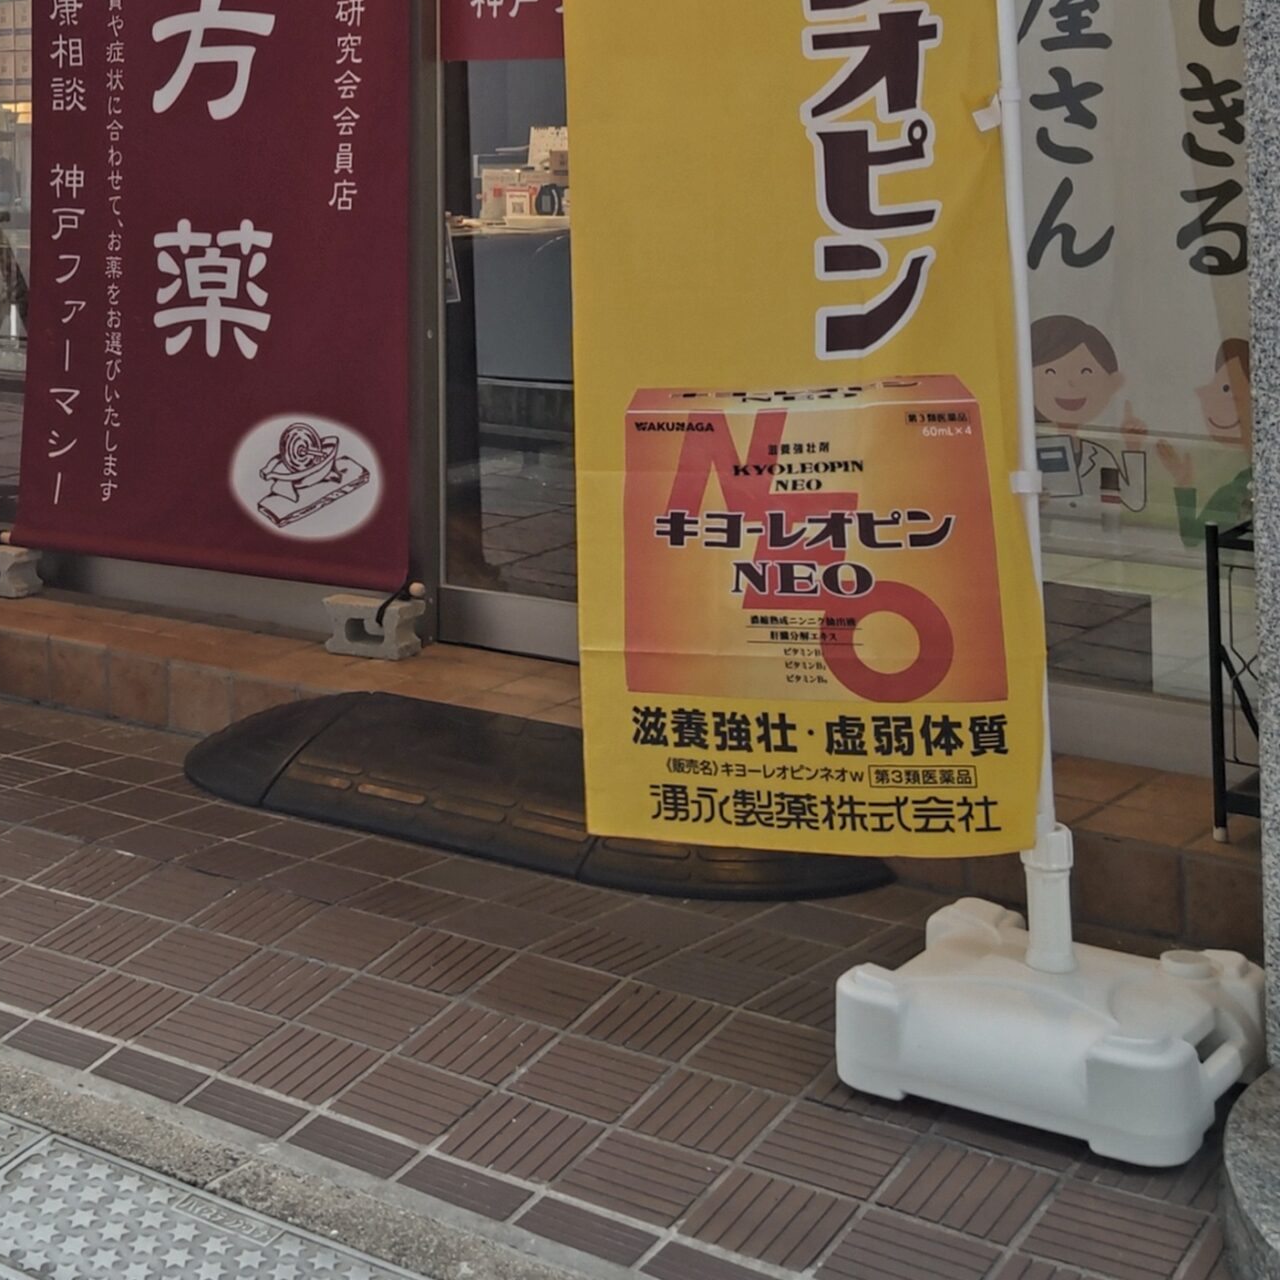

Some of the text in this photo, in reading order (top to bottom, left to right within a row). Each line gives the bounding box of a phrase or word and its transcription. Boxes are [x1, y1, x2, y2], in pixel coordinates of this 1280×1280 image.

[47, 162, 87, 505] 神戸ファーマシー
[634, 421, 715, 433] WAKUNAGA
[731, 459, 865, 478] KYOLEOPIN
[774, 478, 823, 492] NEO
[654, 509, 957, 550] キヨーレオピン
[731, 559, 874, 597] NEO
[631, 705, 1010, 757] 滋養強壮・虚弱体質
[873, 767, 974, 786] 第3類医薬品
[649, 783, 1003, 834] 湧永製薬株式会社
